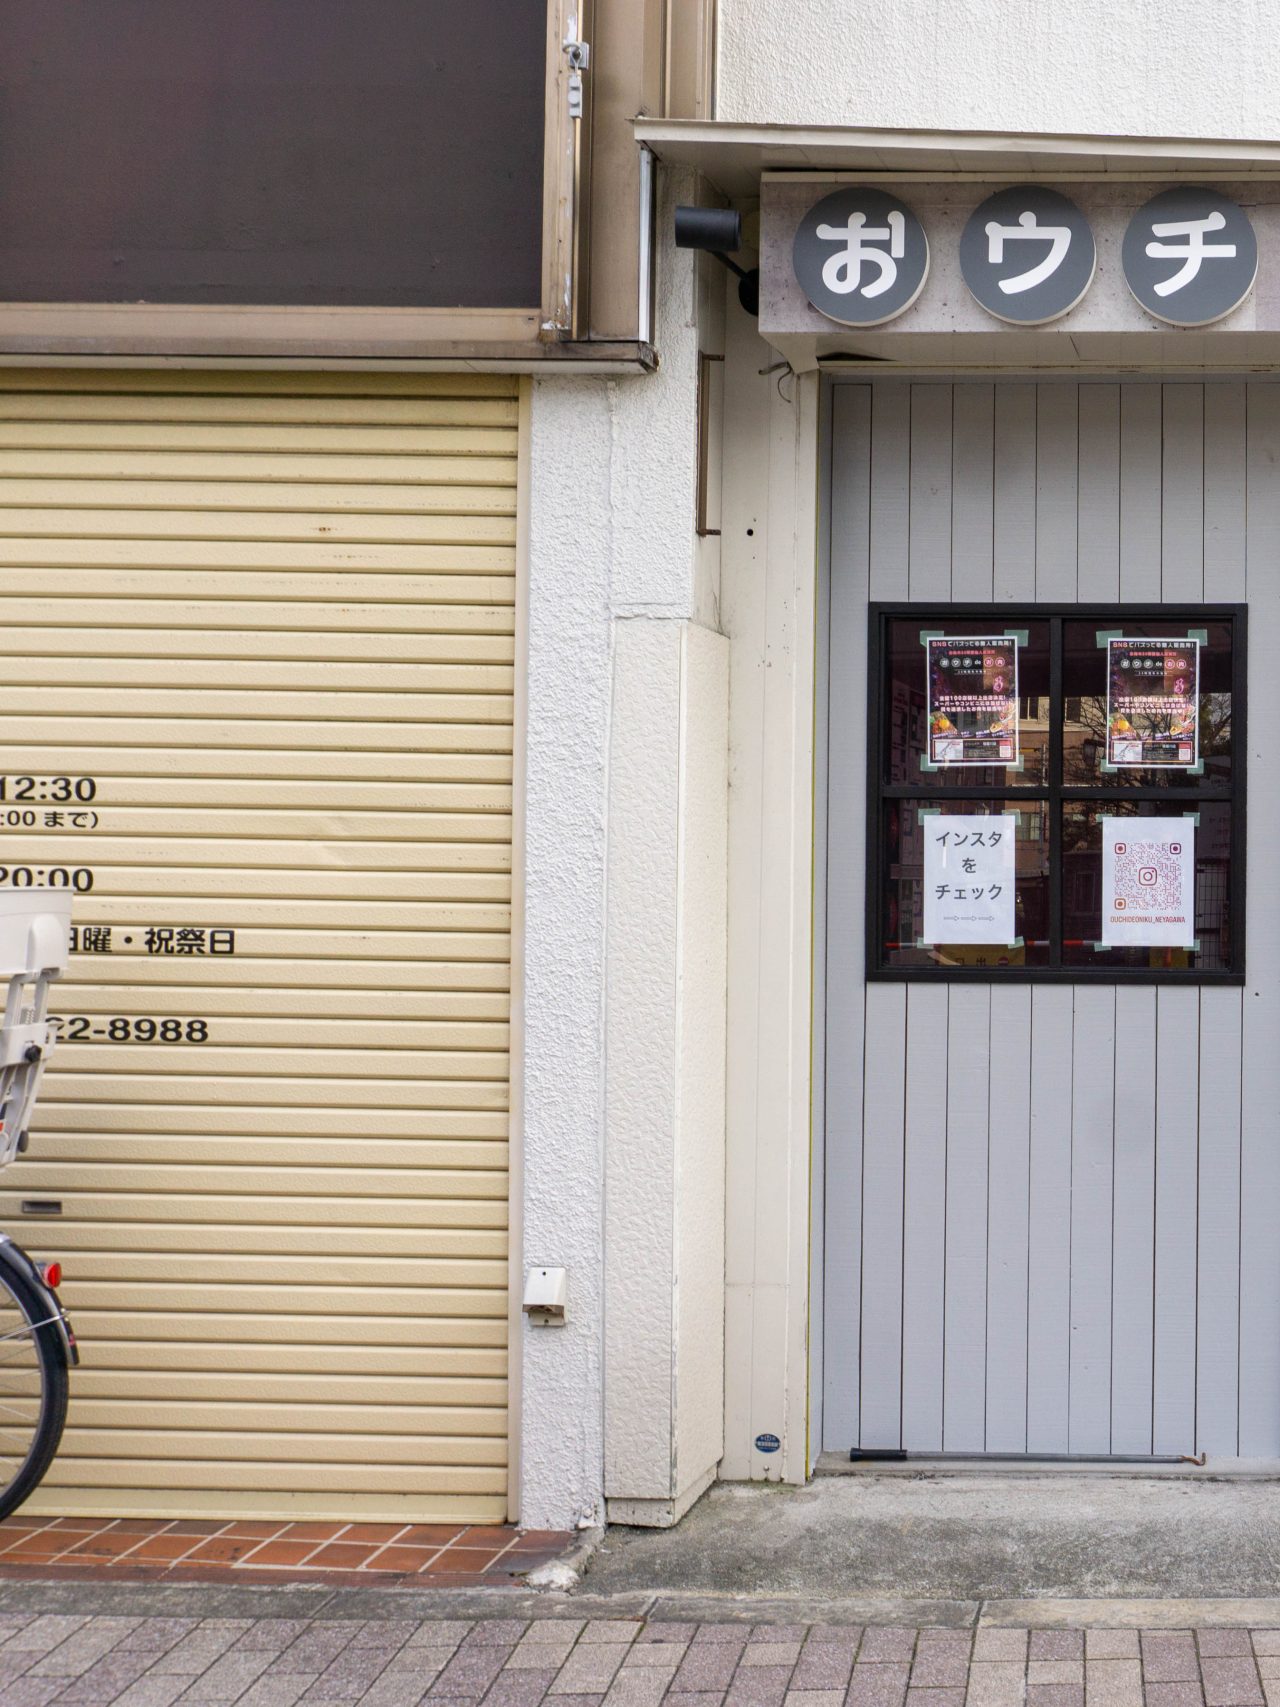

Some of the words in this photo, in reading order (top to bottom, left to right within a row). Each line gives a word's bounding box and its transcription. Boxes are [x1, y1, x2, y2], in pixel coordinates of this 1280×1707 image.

[815, 208, 1239, 301] おウチ
[935, 831, 1003, 849] インスタ
[962, 857, 977, 874] を
[935, 884, 1003, 902] チェック
